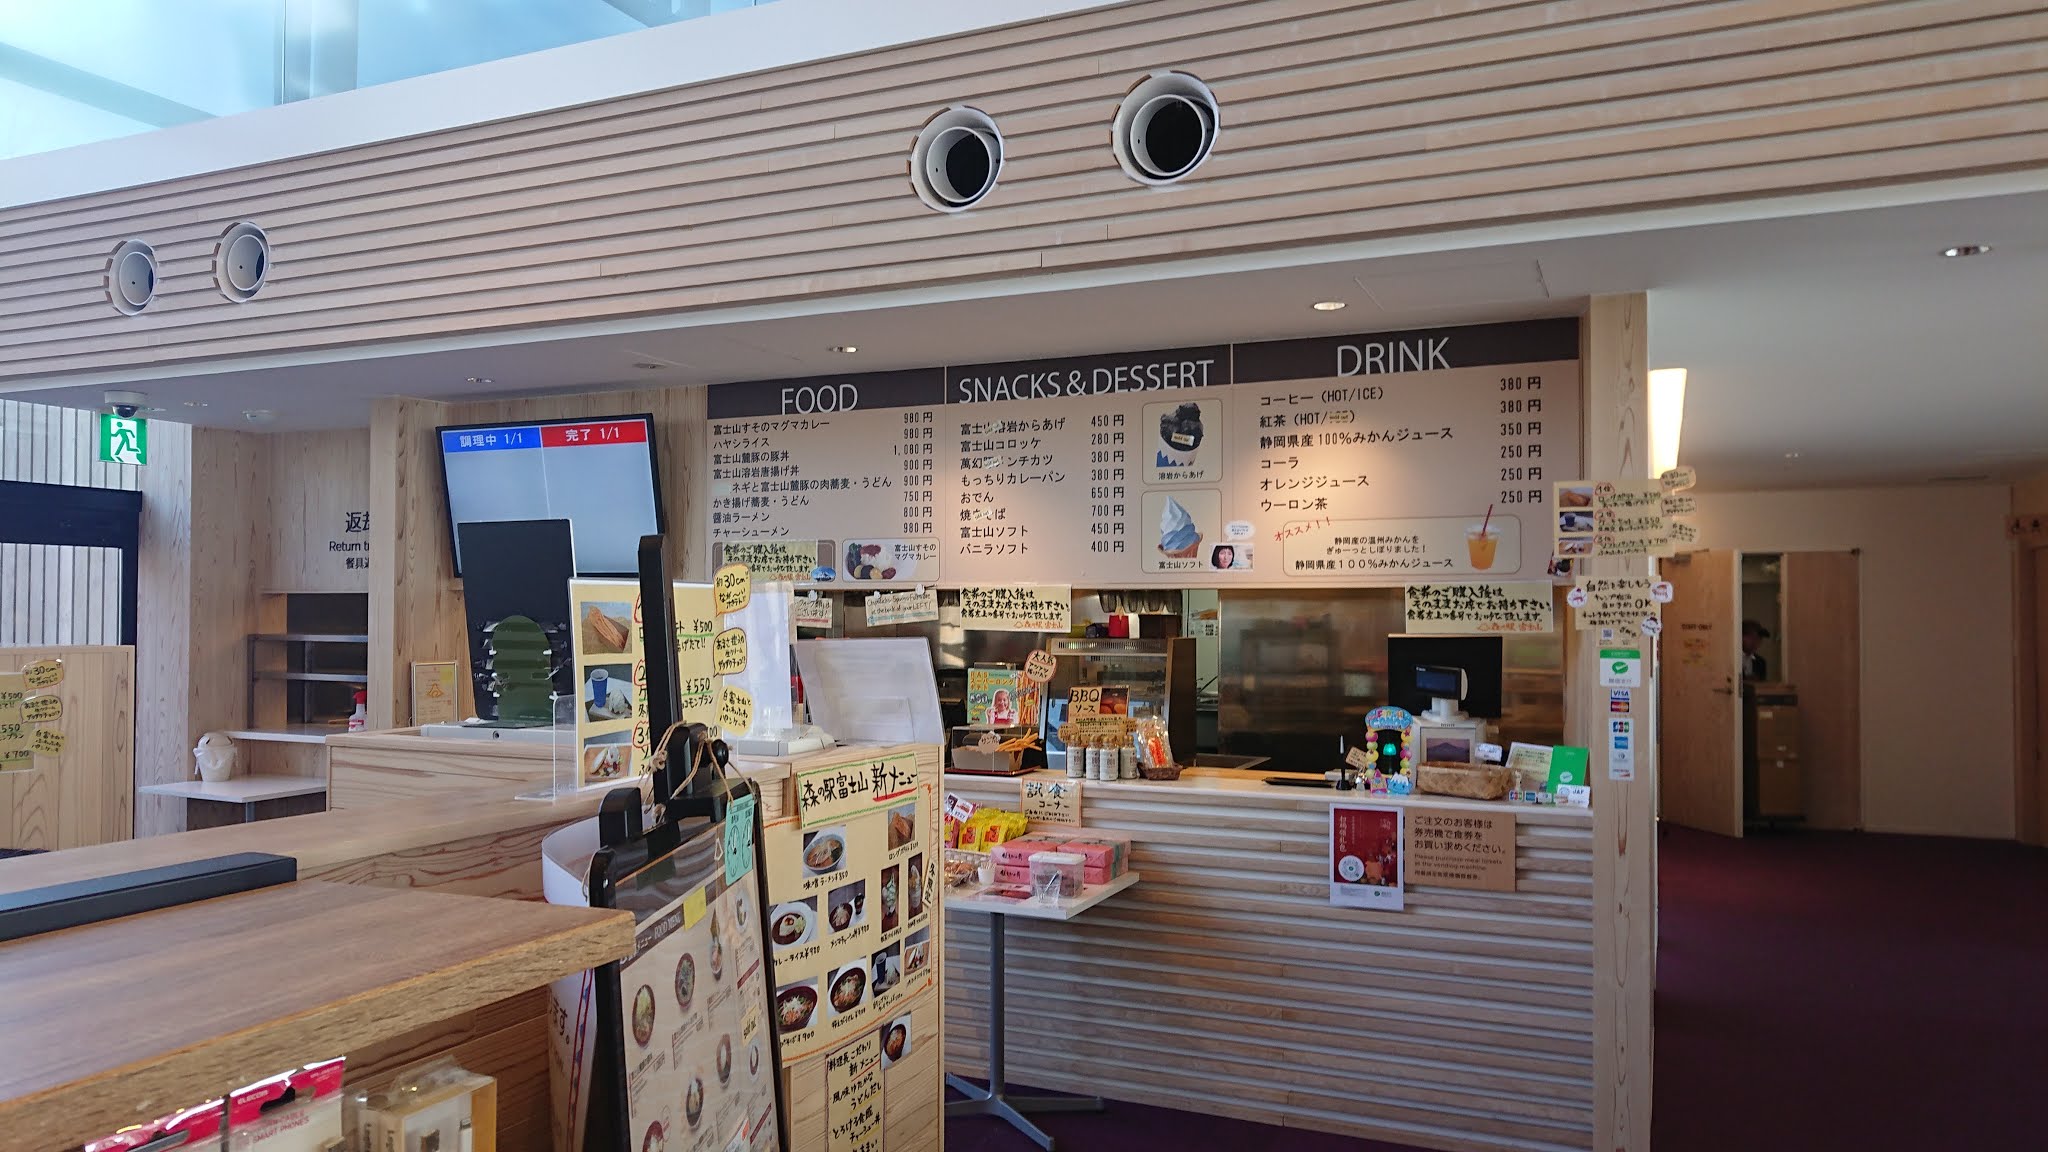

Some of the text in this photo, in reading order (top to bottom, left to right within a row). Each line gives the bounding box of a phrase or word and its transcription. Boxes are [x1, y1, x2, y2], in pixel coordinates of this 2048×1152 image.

[1336, 337, 1450, 377] DRINK
[781, 384, 858, 415] FOOD
[1260, 394, 1314, 406] コーヒー
[713, 419, 830, 436] 富士山すそのマグマカレー
[1259, 414, 1286, 428] 紅茶
[459, 432, 522, 448] 調理中 1/1
[565, 426, 620, 442] 完了 1/1
[713, 437, 770, 450] ハヤシライス
[960, 437, 1041, 452] 富士山コロッケ
[713, 450, 790, 466] 富士山麓豚の豚丼
[1260, 456, 1299, 470] コーラ
[961, 471, 1065, 487] もっちりカレーパン
[1158, 470, 1204, 480] 溶岩からあげ
[1260, 475, 1370, 491] オレンジジュース
[960, 491, 994, 504] おでん
[1260, 497, 1328, 512] ウーロン茶
[712, 527, 790, 538] チャーシューメン
[960, 524, 1029, 539] 富士山ソフト
[329, 541, 361, 552] Return
[894, 543, 937, 552] 富士山すその
[960, 541, 1029, 555] バニラソフト
[894, 552, 937, 561] マグマカレー
[1158, 560, 1204, 570] 富士山ソフト
[686, 677, 711, 692] ¥550
[1068, 688, 1100, 704] BBQ
[1075, 704, 1096, 714] ソース
[870, 762, 917, 799] 新メニュー
[1038, 800, 1070, 810] コーナー
[1415, 816, 1493, 829] ご注文のお客様は
[1415, 828, 1482, 840] 券売機で食券を
[1415, 840, 1506, 854] お買い求めください。
[851, 1082, 882, 1110] うどんだし
